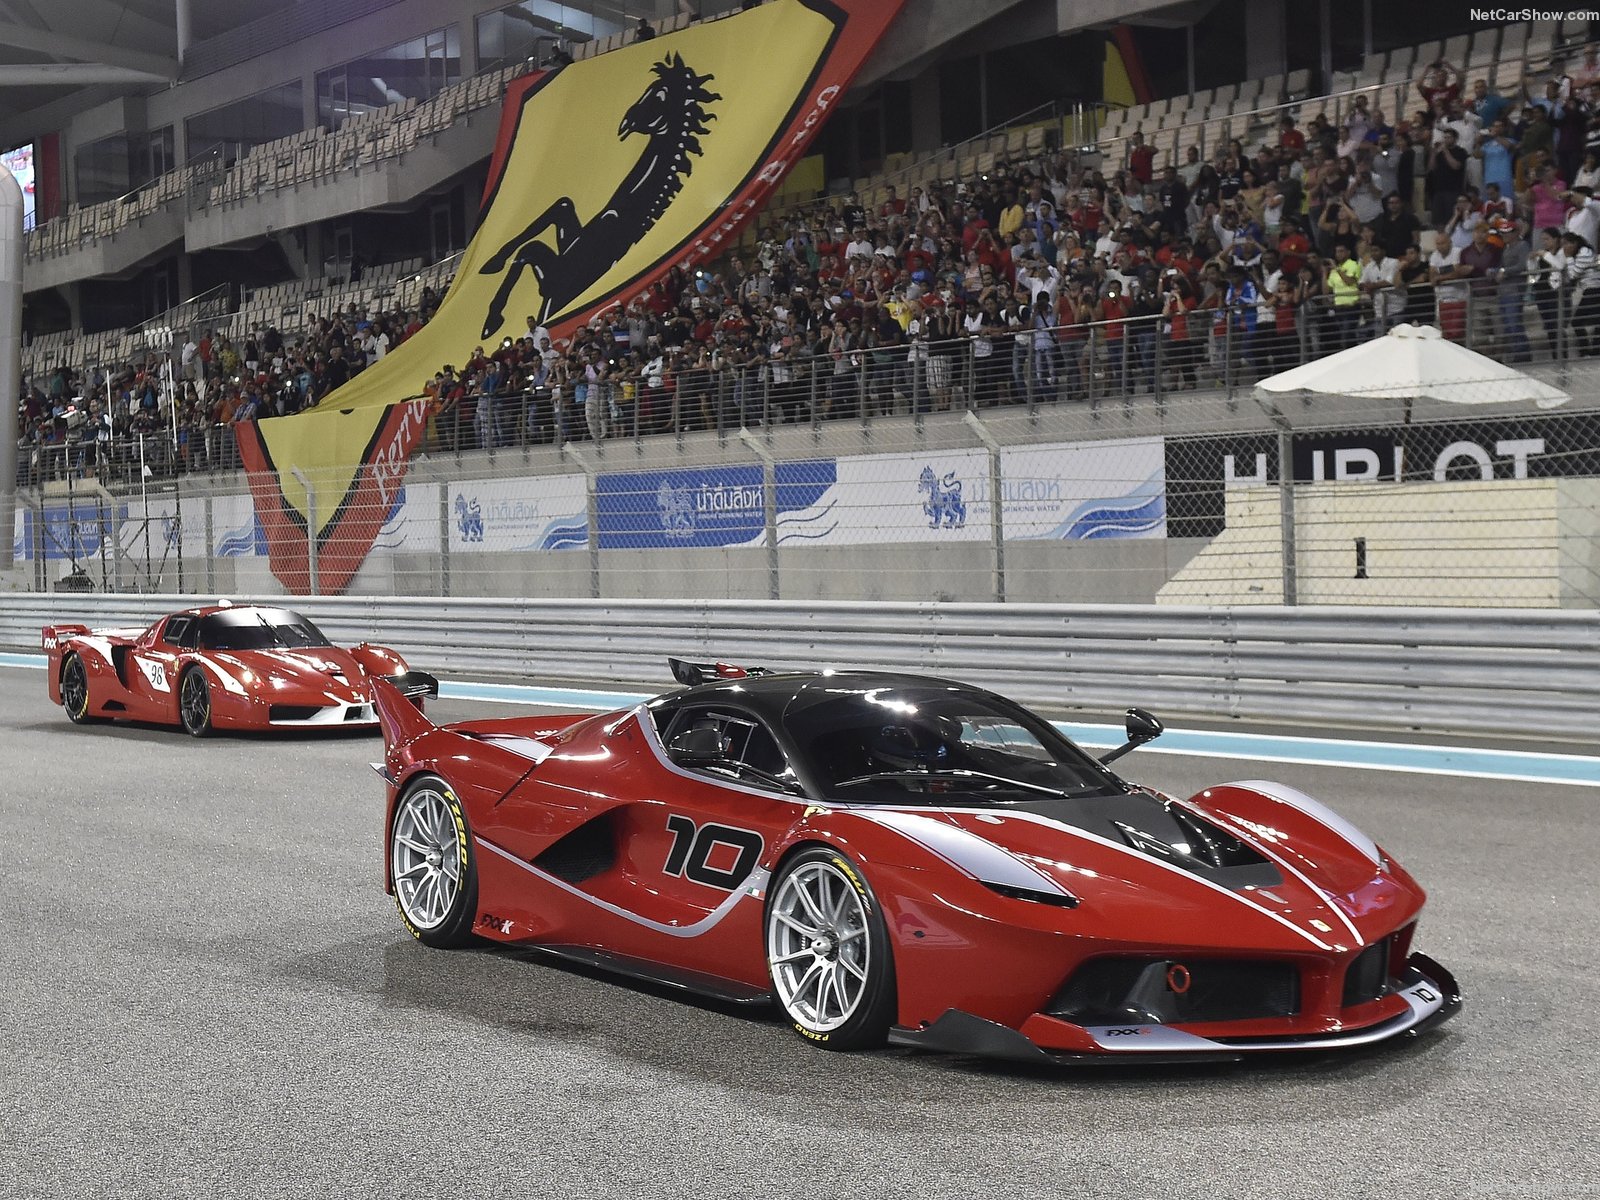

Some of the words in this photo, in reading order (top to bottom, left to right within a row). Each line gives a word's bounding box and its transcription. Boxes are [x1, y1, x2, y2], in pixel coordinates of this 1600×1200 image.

[1224, 438, 1545, 483] HBOT
[1037, 504, 1061, 512] WATER
[44, 637, 57, 649] FXX
[151, 664, 163, 687] 98
[662, 813, 764, 893] 10
[1409, 987, 1437, 1004] 10
